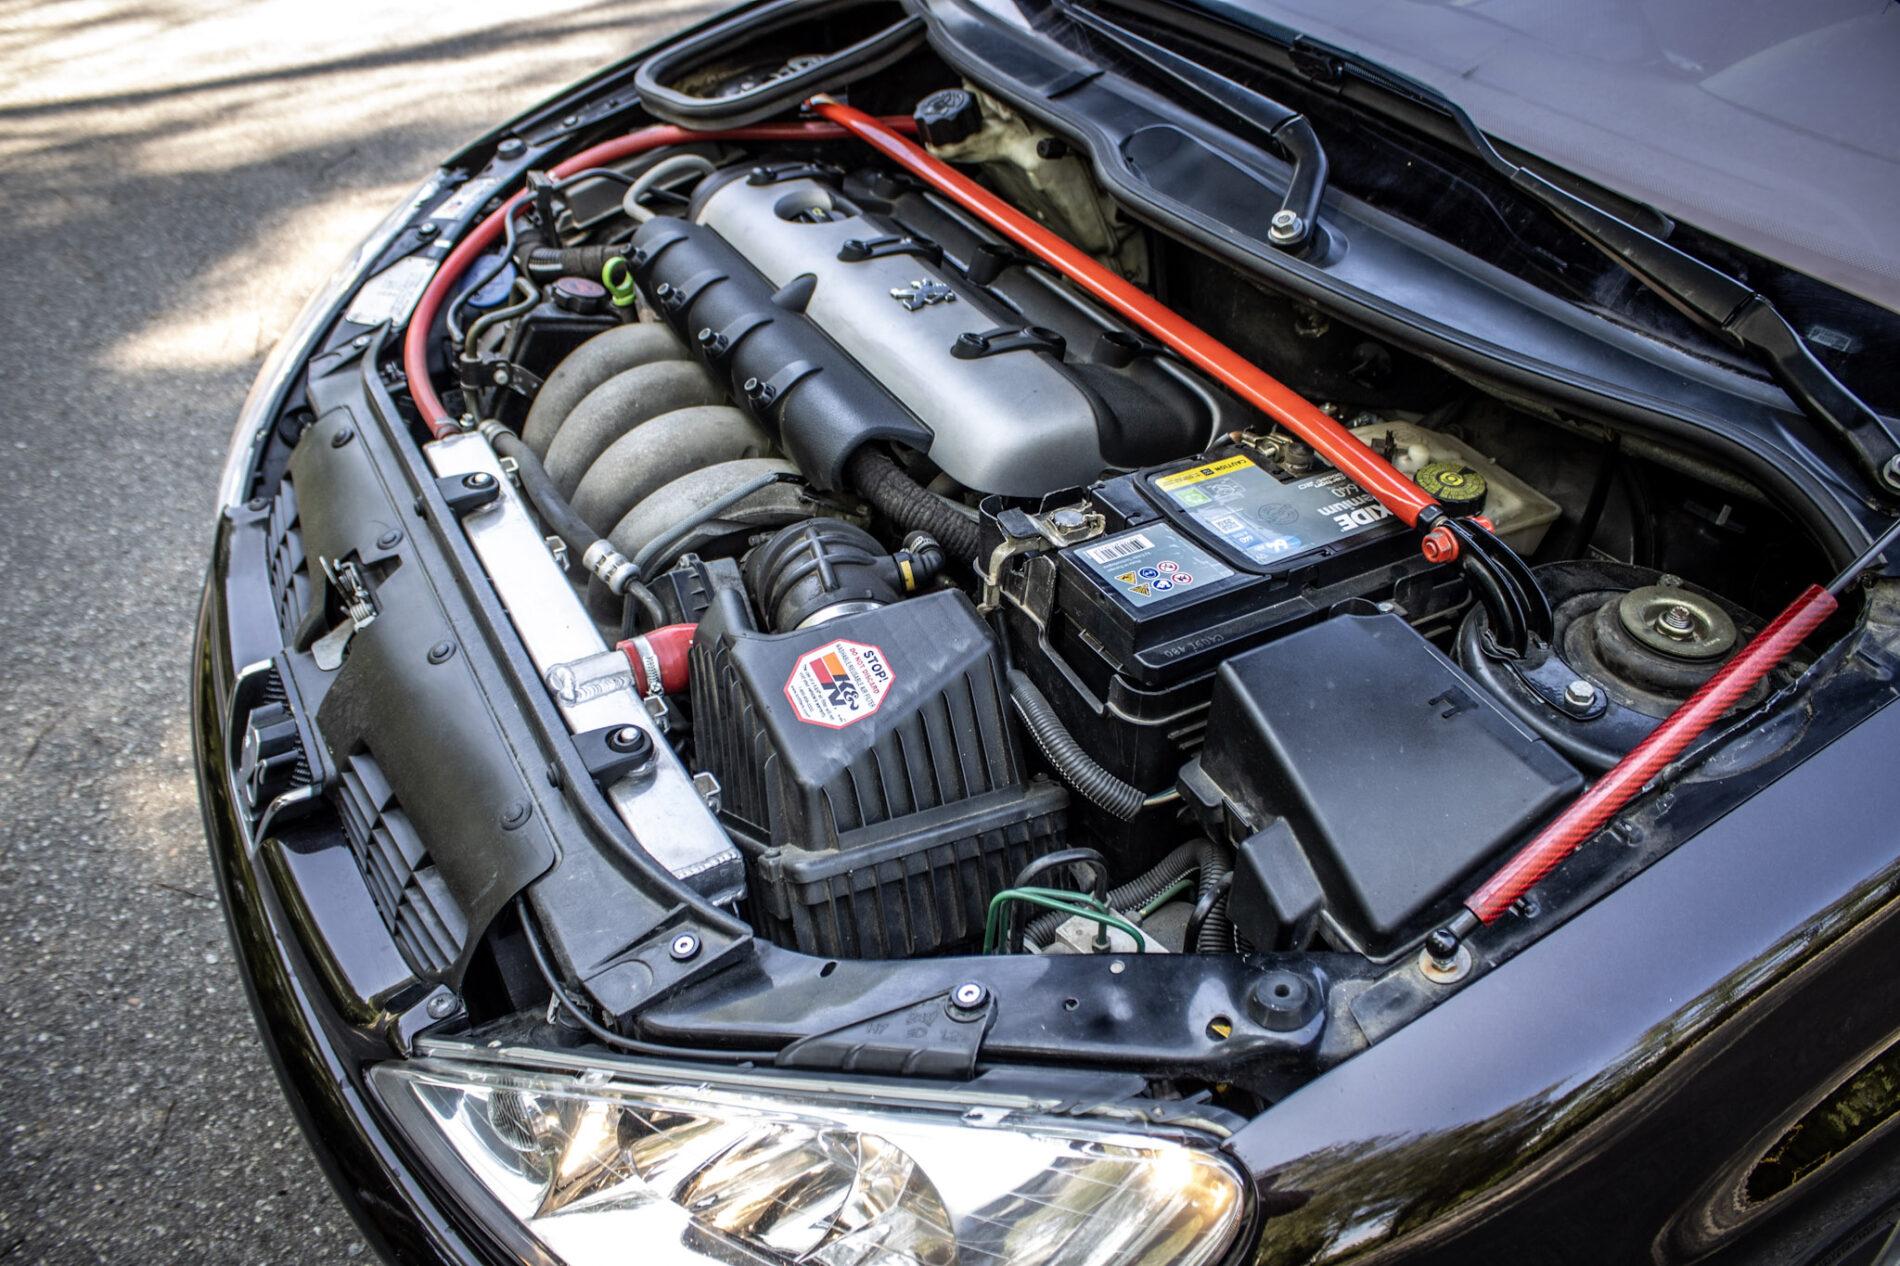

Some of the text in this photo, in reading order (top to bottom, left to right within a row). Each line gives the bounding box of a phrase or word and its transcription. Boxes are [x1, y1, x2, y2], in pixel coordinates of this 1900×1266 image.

[1317, 493, 1377, 516] emium
[1333, 503, 1394, 533] XIDE
[864, 650, 889, 683] STOP!
